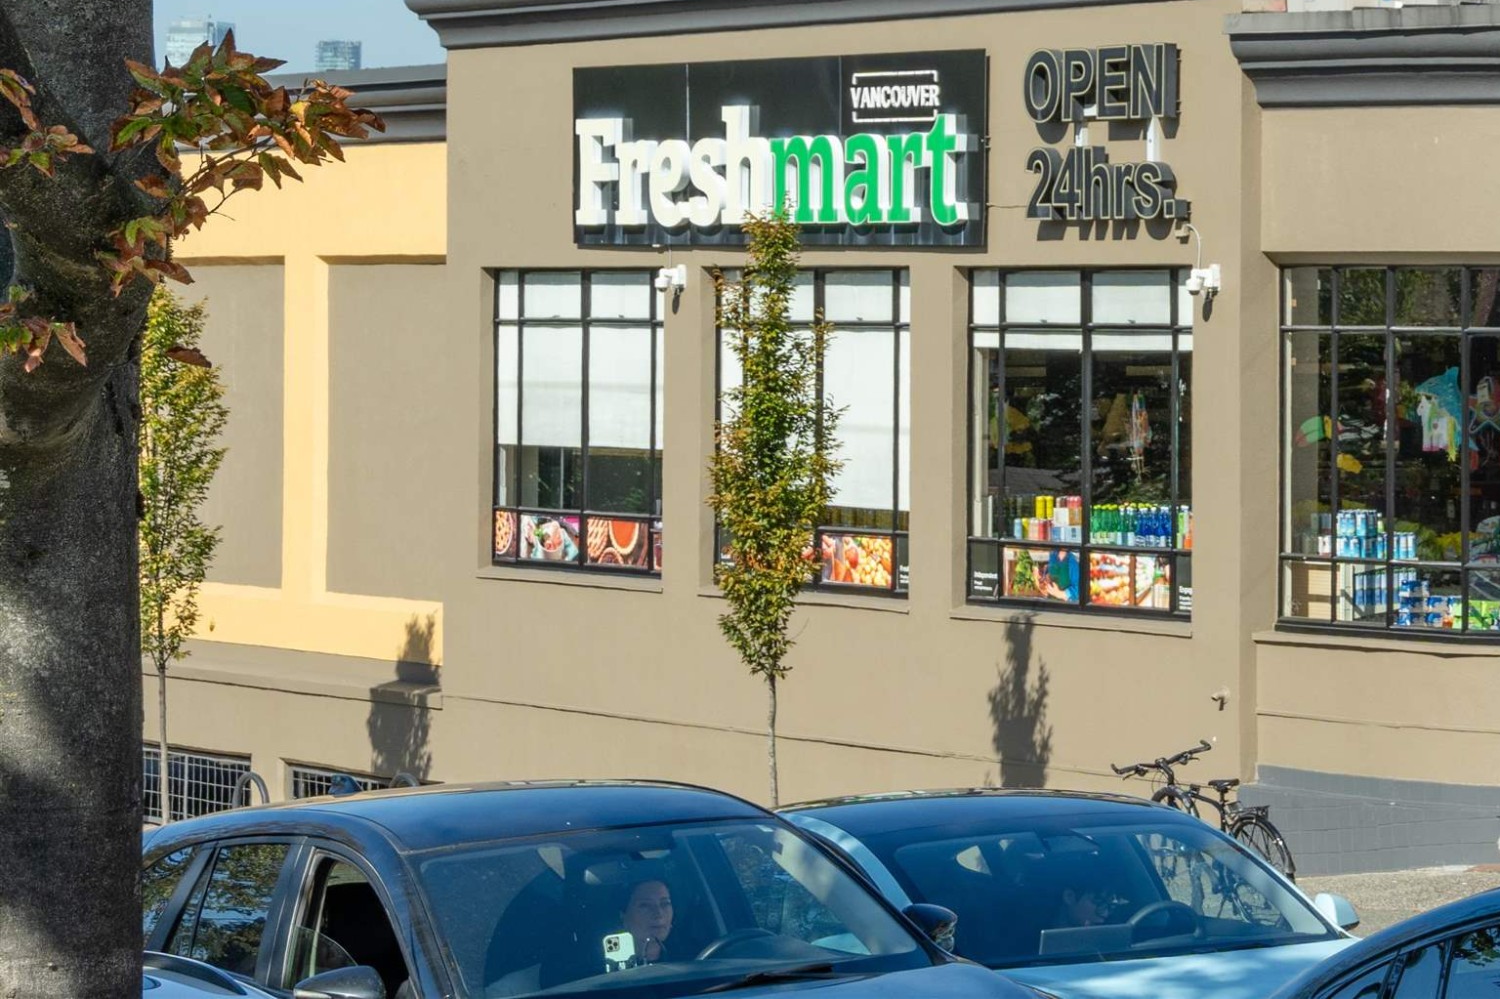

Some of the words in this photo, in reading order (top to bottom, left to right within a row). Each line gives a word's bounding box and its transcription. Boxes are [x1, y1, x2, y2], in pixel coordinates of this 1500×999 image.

[850, 85, 940, 109] VANCOUVER
[1024, 42, 1168, 123] OPEN
[576, 105, 966, 227] Freshmart
[1025, 147, 1176, 220] 24hrs.
